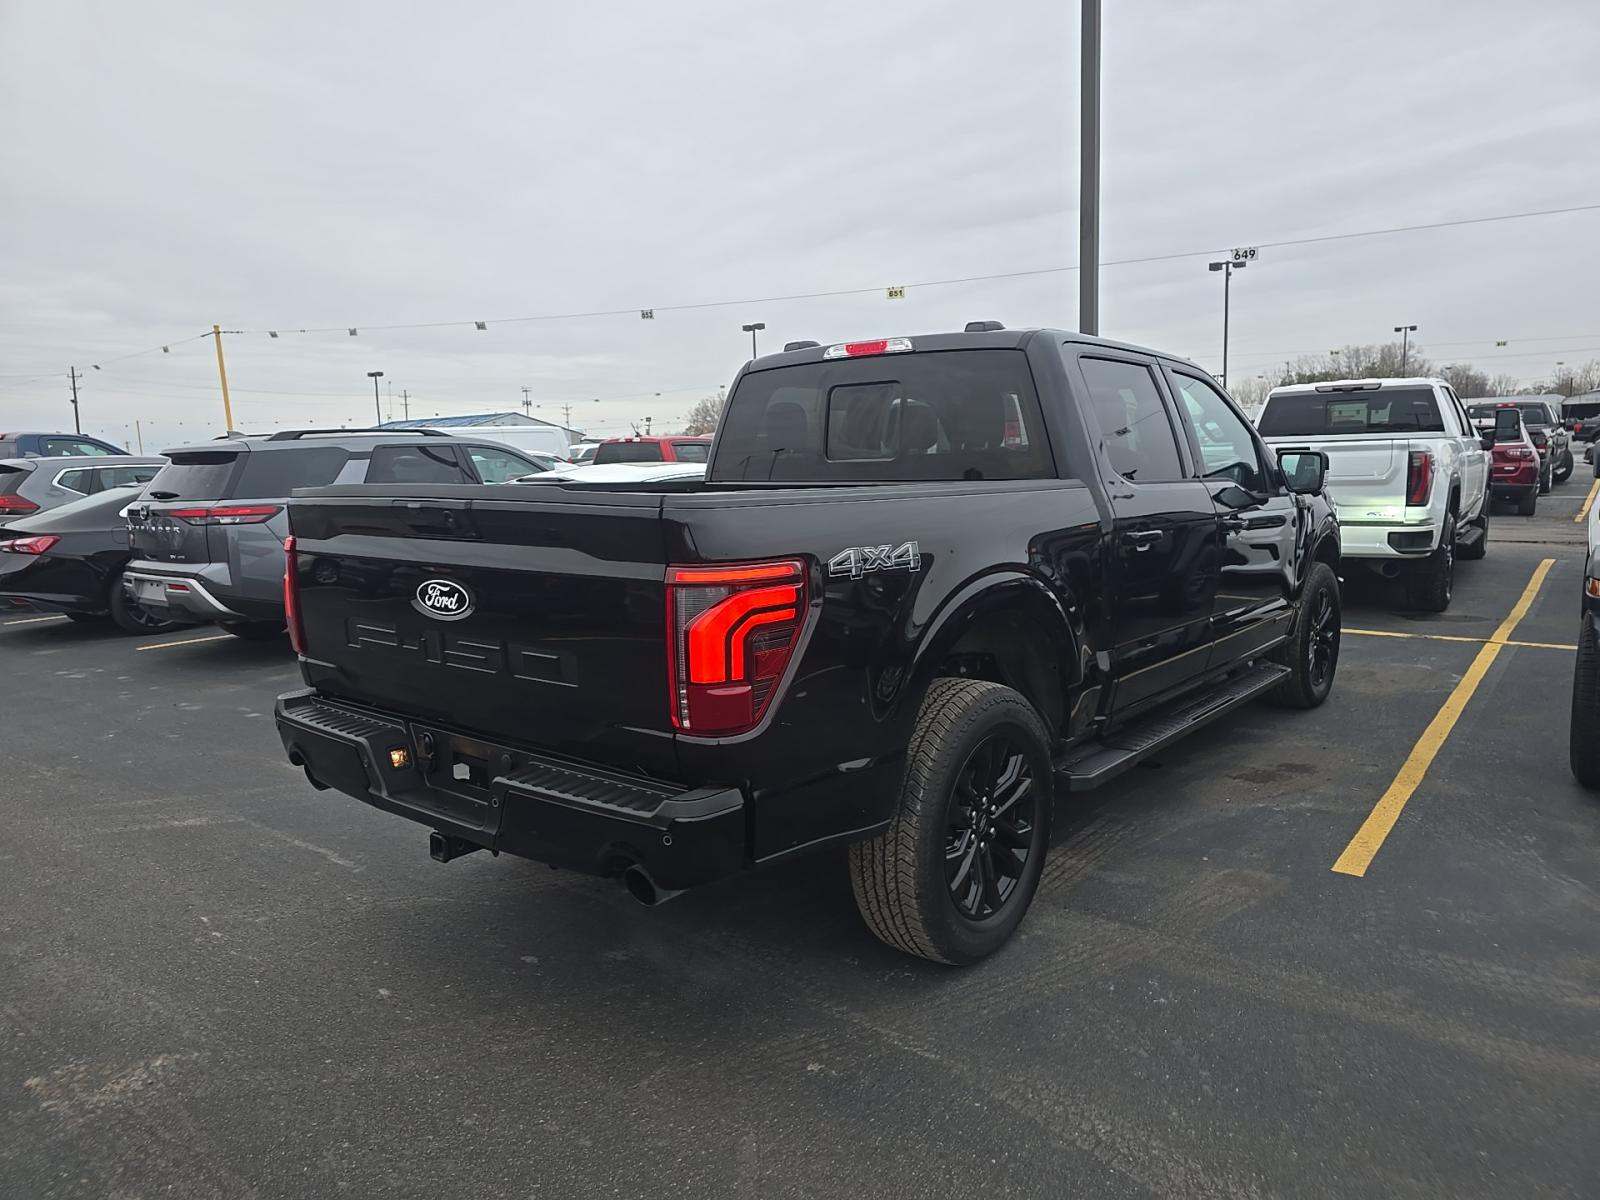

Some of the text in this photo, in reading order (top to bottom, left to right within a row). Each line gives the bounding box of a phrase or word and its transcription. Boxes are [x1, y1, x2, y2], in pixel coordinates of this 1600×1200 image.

[1234, 247, 1256, 260] 649
[424, 583, 460, 610] Ford
[346, 617, 579, 688] F-150
